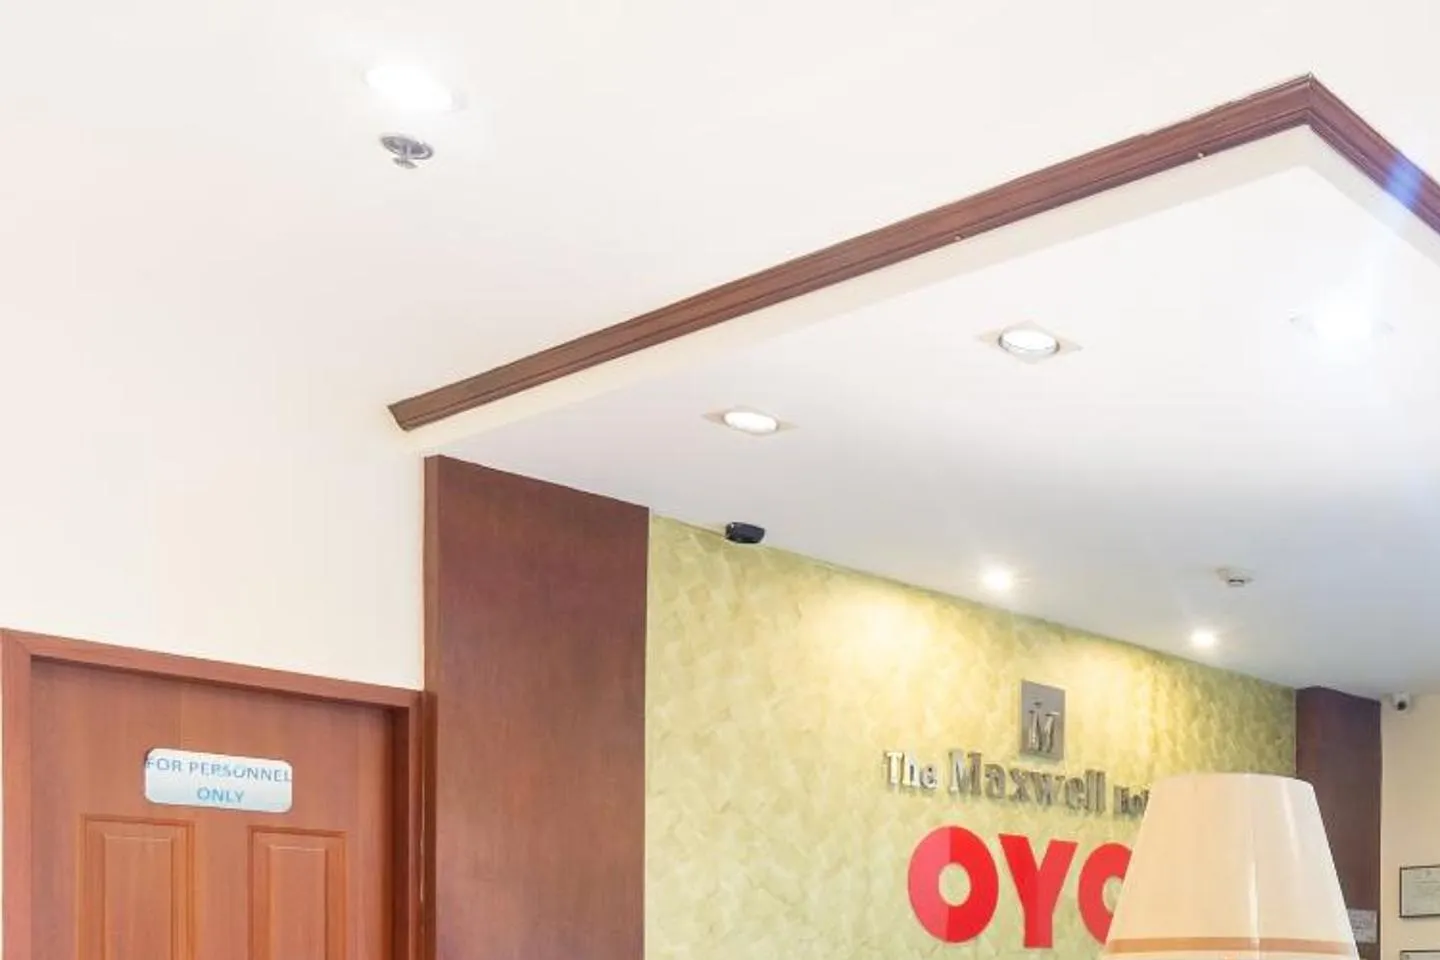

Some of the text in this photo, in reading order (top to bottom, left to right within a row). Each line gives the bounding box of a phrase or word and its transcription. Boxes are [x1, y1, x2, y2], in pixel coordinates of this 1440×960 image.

[189, 761, 293, 783] PERSONNEL
[885, 750, 938, 791] The
[948, 749, 1106, 815] Maxwell
[196, 786, 245, 804] ONLY
